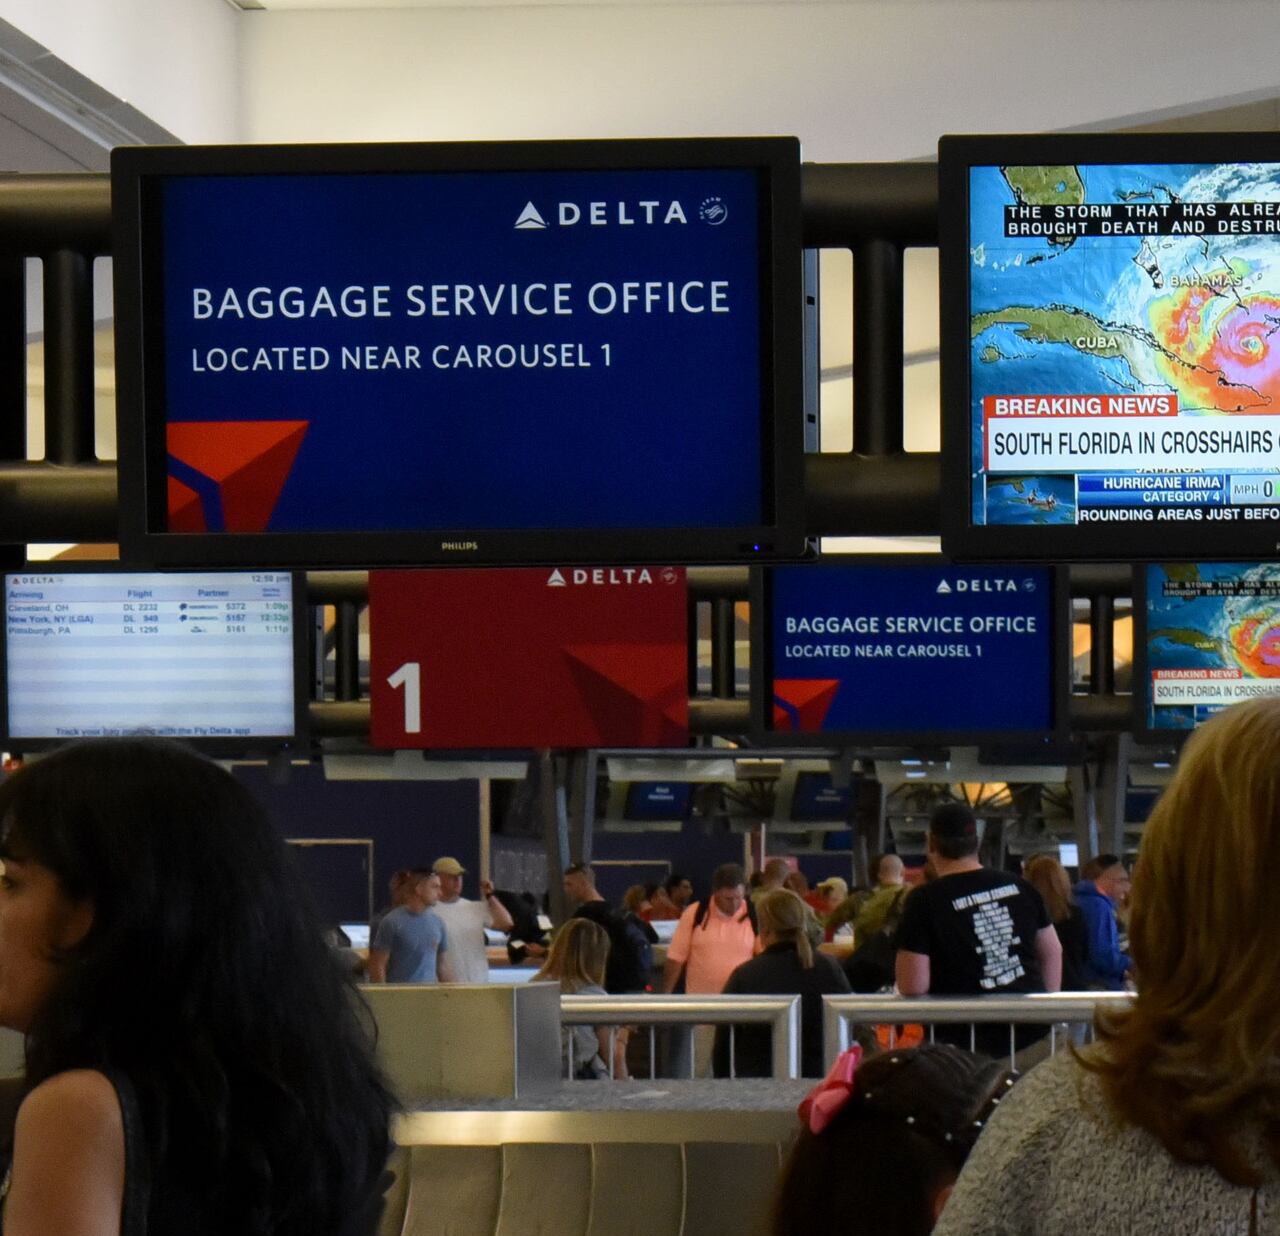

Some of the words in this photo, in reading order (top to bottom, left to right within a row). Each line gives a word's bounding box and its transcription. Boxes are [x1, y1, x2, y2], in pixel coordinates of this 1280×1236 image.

[558, 200, 688, 226] DELTA
[1008, 206, 1042, 218] THE
[1054, 206, 1112, 218] STORM
[1125, 205, 1170, 218] THAT
[1183, 204, 1216, 217] HAS
[1008, 222, 1088, 235] BROUGHT
[1102, 222, 1158, 234] DEATH
[1172, 221, 1204, 234] AND
[1170, 275, 1242, 288] BAHAMAS
[192, 284, 392, 320] BAGGAGE
[406, 282, 572, 317] SERVICE
[588, 280, 730, 315] OFFICE
[1076, 336, 1118, 350] CUBA
[192, 346, 330, 372] LOCATED
[341, 345, 421, 370] NEAR
[432, 343, 591, 369] CAROUSEL
[601, 344, 612, 366] 1
[996, 398, 1102, 415] BREAKING
[1108, 397, 1170, 414] NEWS
[994, 432, 1052, 455] SOUTH
[1058, 432, 1133, 455] FLORIDA
[1138, 432, 1155, 454] IN
[1161, 430, 1274, 454] CROSSHAIRS
[1103, 477, 1182, 489] HURRICANE
[1186, 476, 1221, 489] IRMA
[1234, 484, 1258, 495] MPH
[1263, 481, 1273, 498] 0
[1142, 490, 1208, 502] CATEGORY
[1212, 490, 1220, 502] 4
[1078, 510, 1154, 521] ROUNDING
[1158, 509, 1202, 520] AREAS
[1206, 508, 1240, 520] JUST
[442, 541, 478, 550] PHILIPS
[573, 569, 653, 584] DELTA
[956, 579, 1018, 592] DELTA
[786, 617, 879, 634] BAGGAGE
[886, 616, 964, 633] SERVICE
[970, 616, 1036, 632] OFFICE
[785, 645, 850, 657] LOCATED
[855, 645, 893, 657] NEAR
[896, 644, 972, 657] CAROUSEL
[976, 644, 982, 656] 1
[1158, 670, 1208, 678] BREAKING
[1210, 670, 1238, 678] NEWS
[386, 662, 420, 734] 1
[1157, 686, 1184, 697] SOUTH
[1188, 686, 1221, 697] FLORIDA
